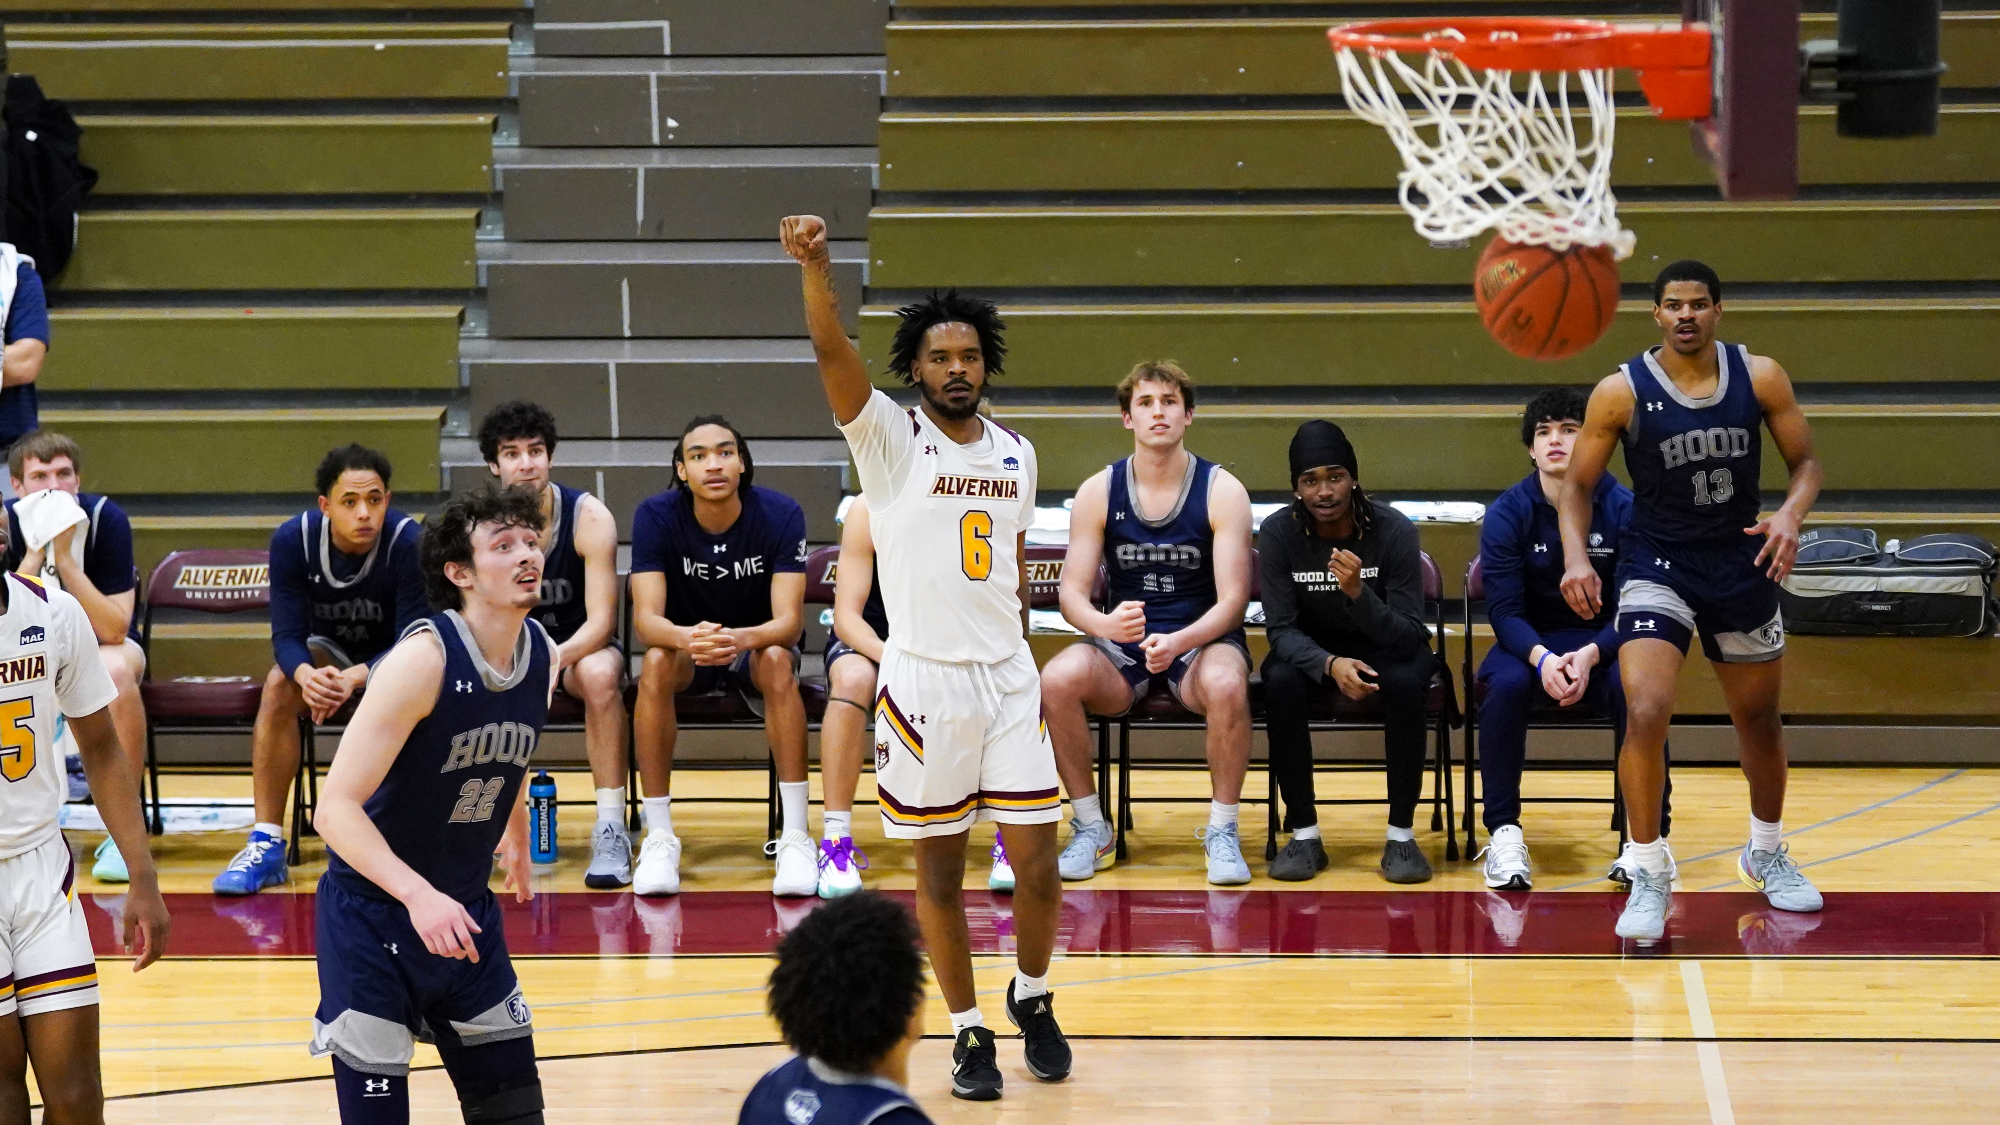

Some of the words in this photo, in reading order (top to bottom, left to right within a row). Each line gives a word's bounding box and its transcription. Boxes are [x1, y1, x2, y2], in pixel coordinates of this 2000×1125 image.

[1659, 427, 1750, 469] HOOD
[932, 476, 1018, 499] ALVERNIA
[1691, 467, 1734, 505] 13
[960, 509, 993, 581] 6
[1116, 542, 1201, 570] HOOD
[179, 566, 270, 586] ALVERNIA
[683, 556, 710, 580] WE
[733, 555, 764, 580] ME
[185, 589, 260, 599] UNIVERSITY
[1143, 572, 1175, 592] 11
[21, 632, 44, 644] MAC
[441, 721, 536, 774] HOOD
[448, 776, 505, 824] 22
[539, 798, 549, 852] POWERADE
